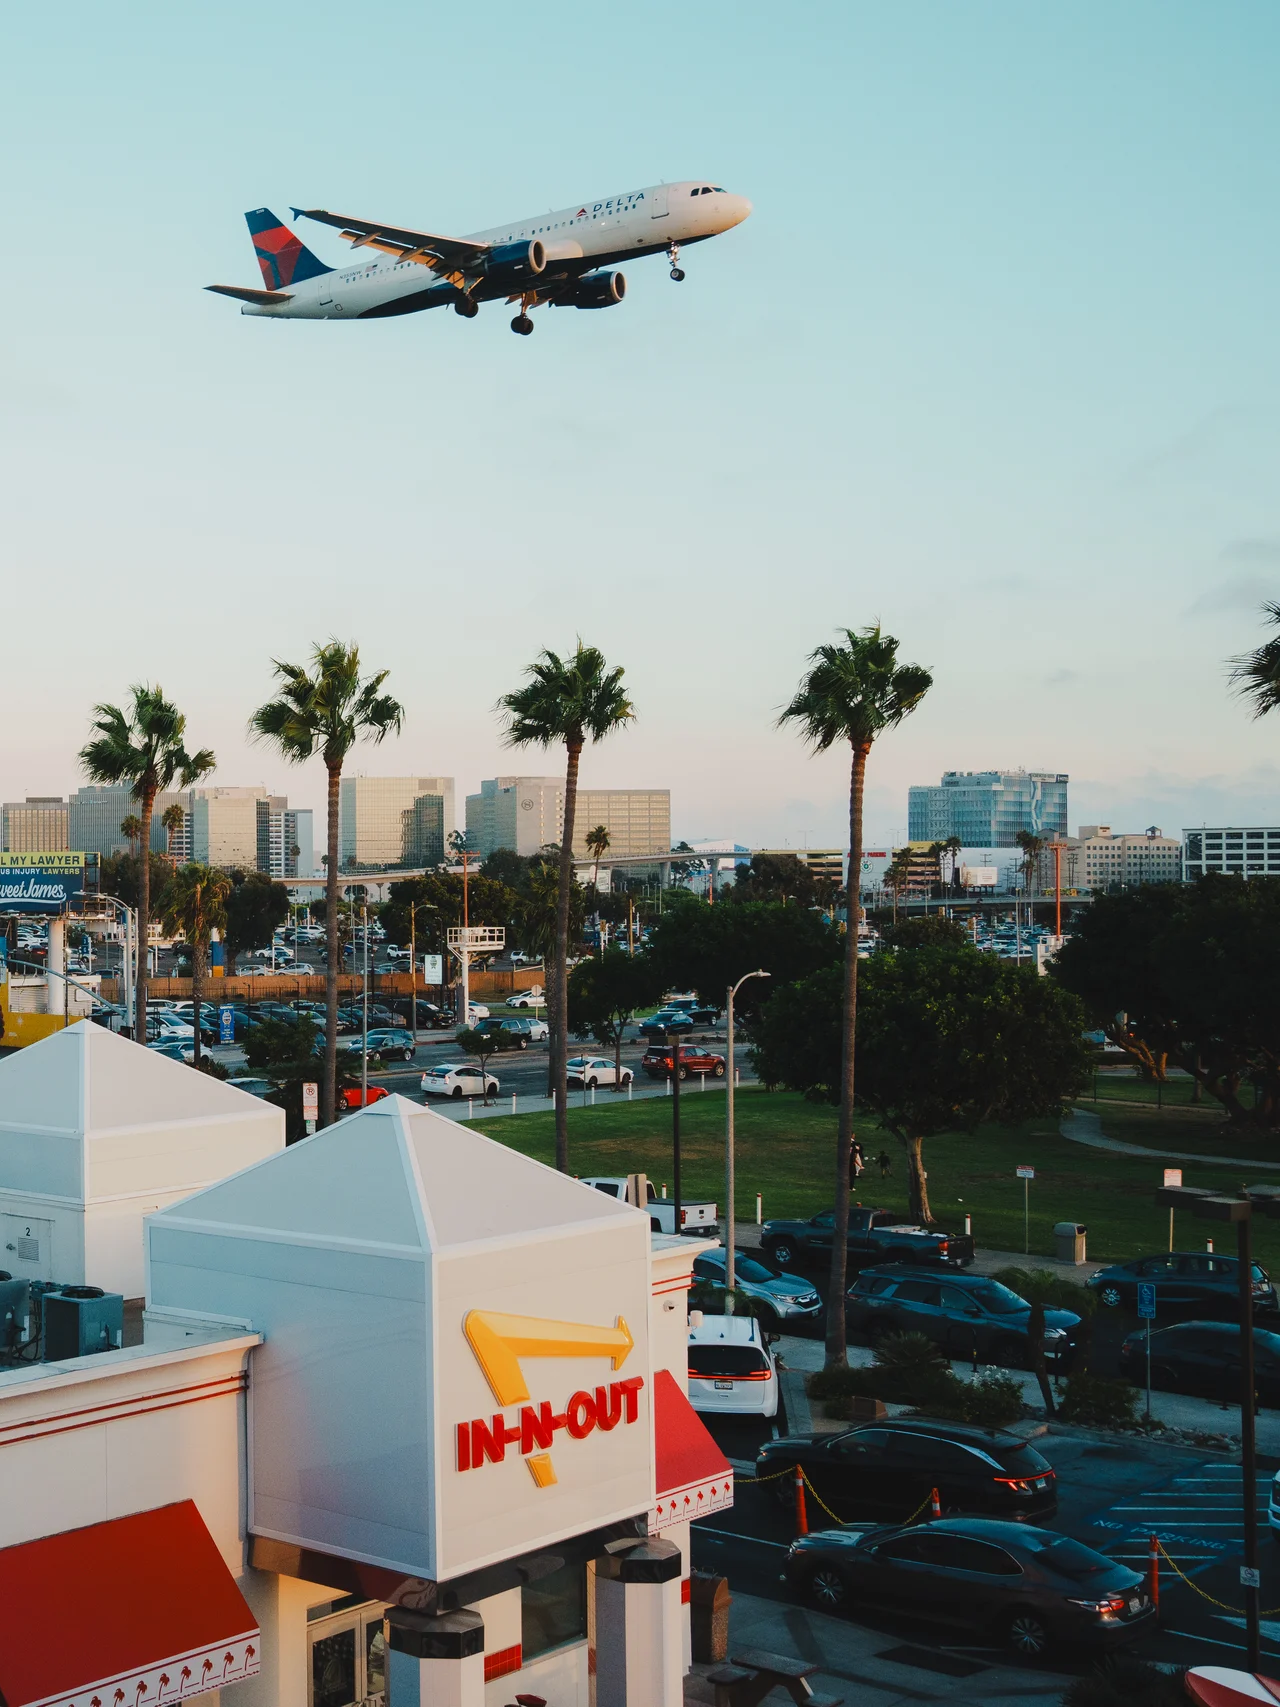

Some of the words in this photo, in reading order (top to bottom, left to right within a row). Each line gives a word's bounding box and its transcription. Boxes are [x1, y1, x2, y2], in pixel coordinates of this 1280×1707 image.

[592, 192, 645, 213] DELTA
[10, 855, 27, 866] MY
[30, 855, 80, 866] LAWYER
[12, 868, 40, 876] INJURY
[42, 868, 80, 876] LAWYERS
[24, 877, 66, 899] James
[455, 1375, 645, 1473] IN-N-OUT
[1092, 1519, 1124, 1529] NO
[1130, 1526, 1227, 1550] PARKING
